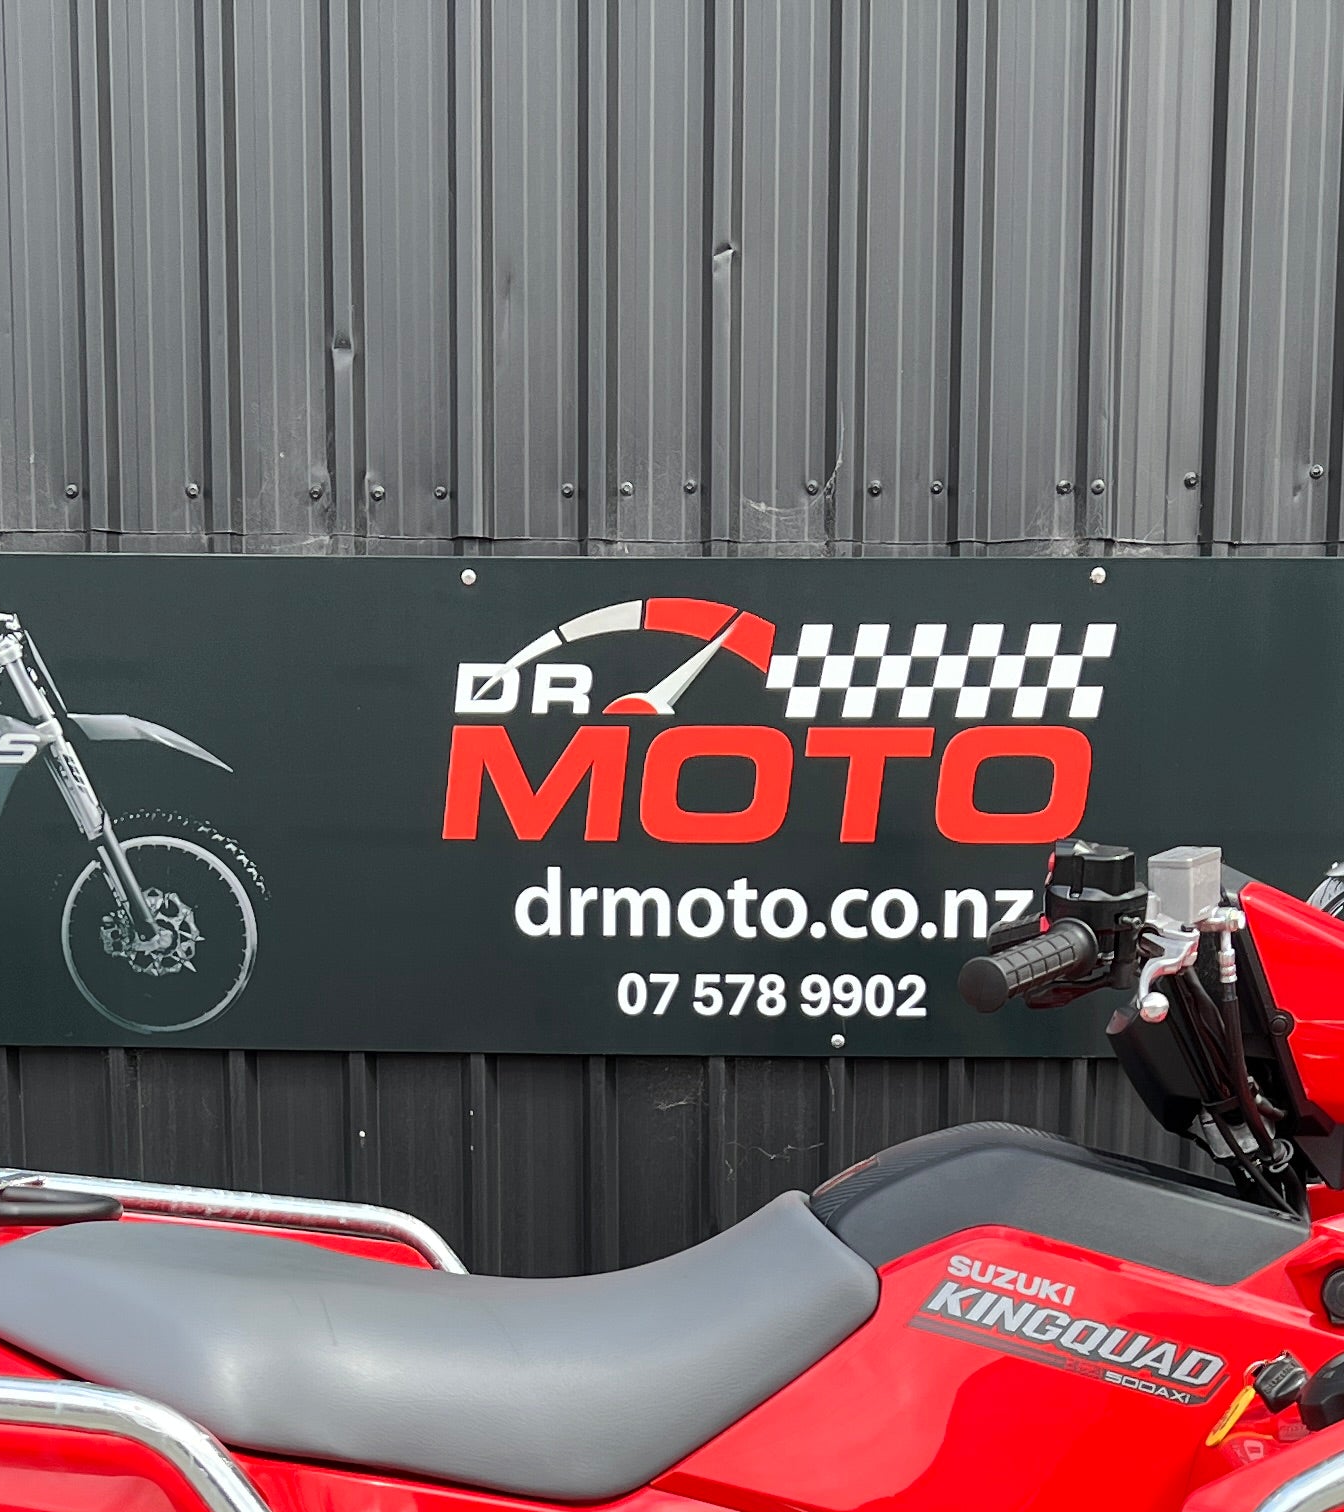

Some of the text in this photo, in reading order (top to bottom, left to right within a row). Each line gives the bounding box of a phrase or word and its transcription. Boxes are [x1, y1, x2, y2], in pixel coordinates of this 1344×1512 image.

[454, 661, 594, 714] DR
[442, 725, 1092, 844] MOTO
[514, 866, 1034, 939] drmoto.co.nz
[617, 973, 927, 1017] 07 578 9902
[946, 1255, 1076, 1306] SUZUKI
[927, 1282, 1226, 1386] KINGQUAD
